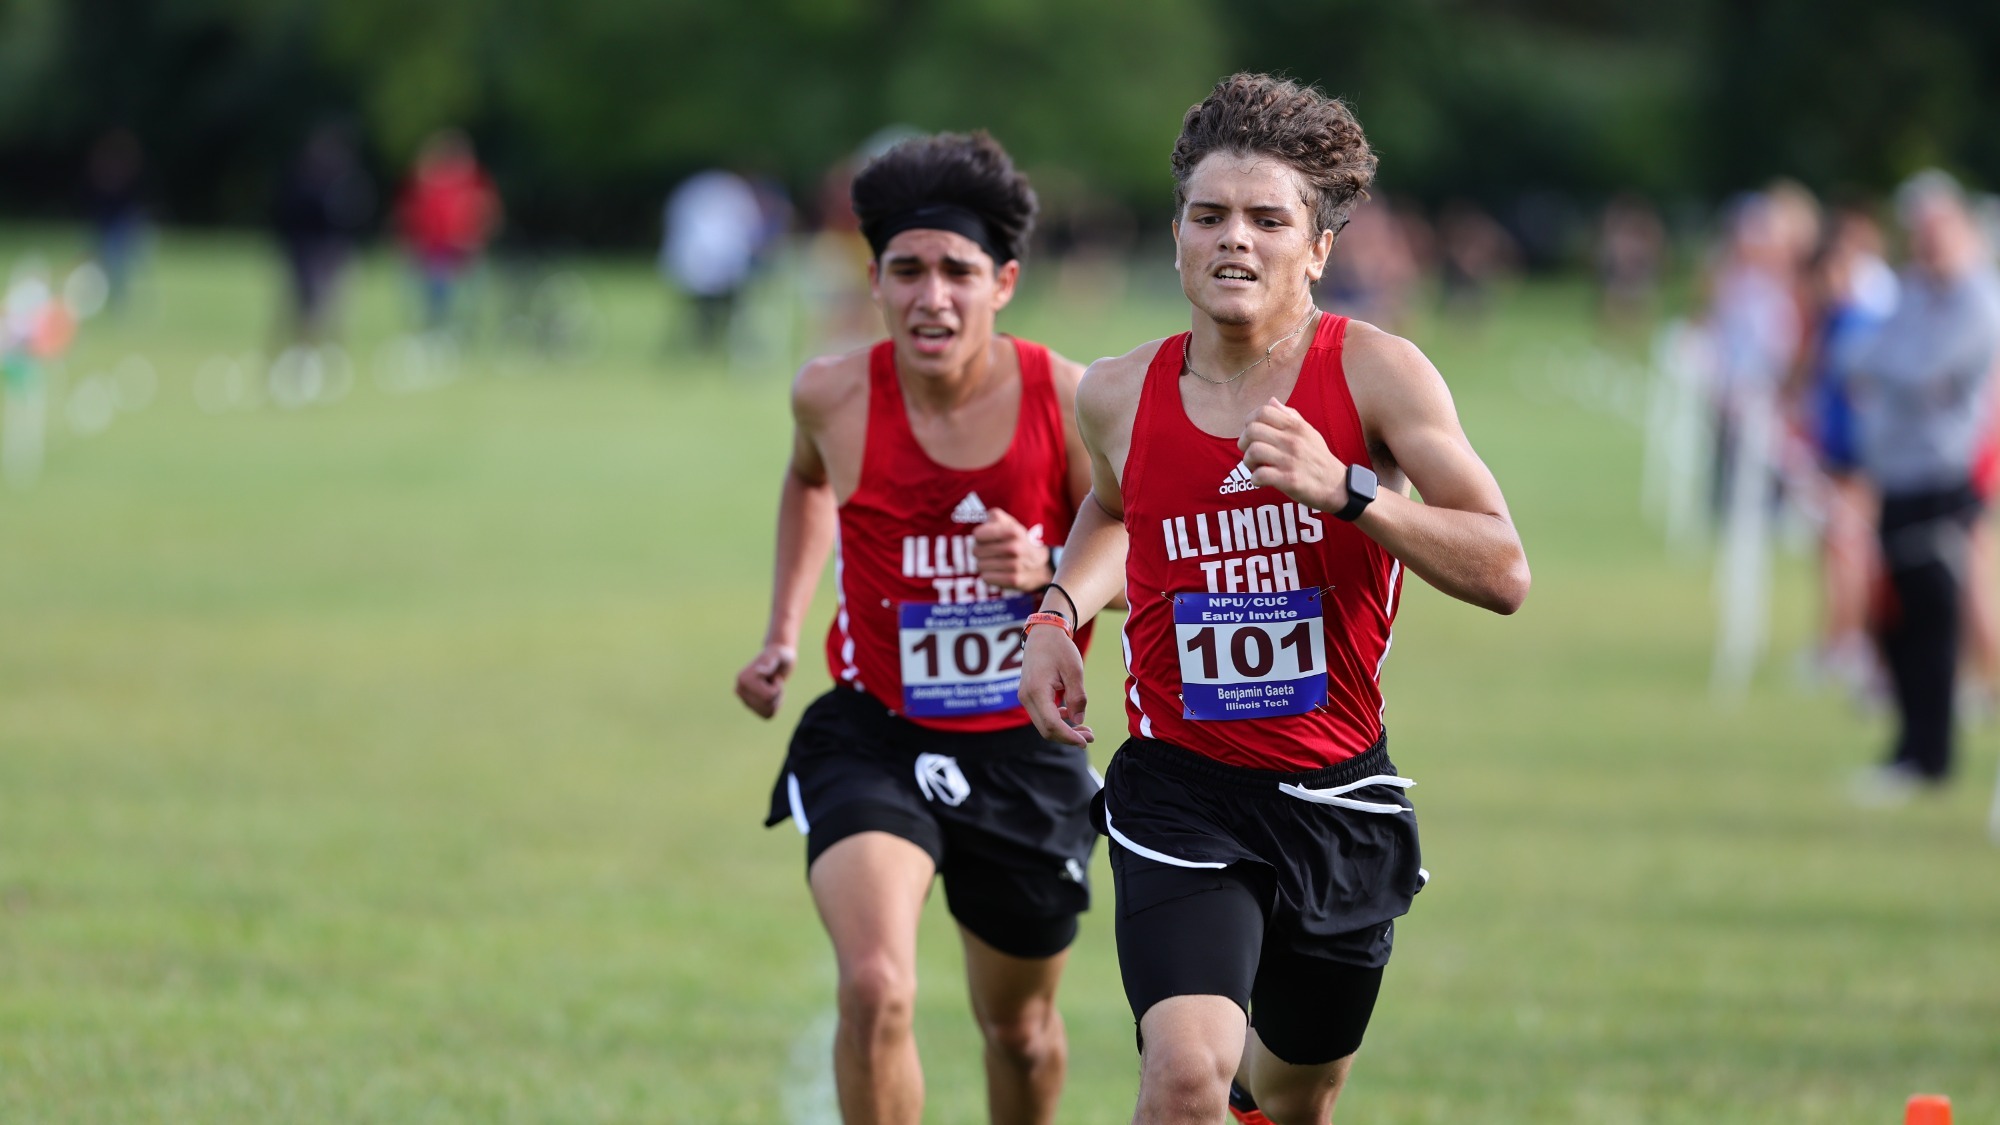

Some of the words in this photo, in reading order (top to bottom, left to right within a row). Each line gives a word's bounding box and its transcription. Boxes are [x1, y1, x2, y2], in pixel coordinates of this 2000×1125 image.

[1162, 503, 1323, 561] ILLINOIS
[1200, 551, 1300, 593] TECH
[1202, 611, 1244, 622] Early
[1249, 610, 1298, 620] Invite
[1209, 596, 1288, 608] NPU/CUC
[912, 627, 1022, 678] 102
[1187, 622, 1314, 679] 101
[1218, 686, 1263, 701] Benjamin
[1265, 685, 1294, 696] Gaeta
[1226, 701, 1260, 711] Illinois
[1263, 699, 1289, 708] Tech
